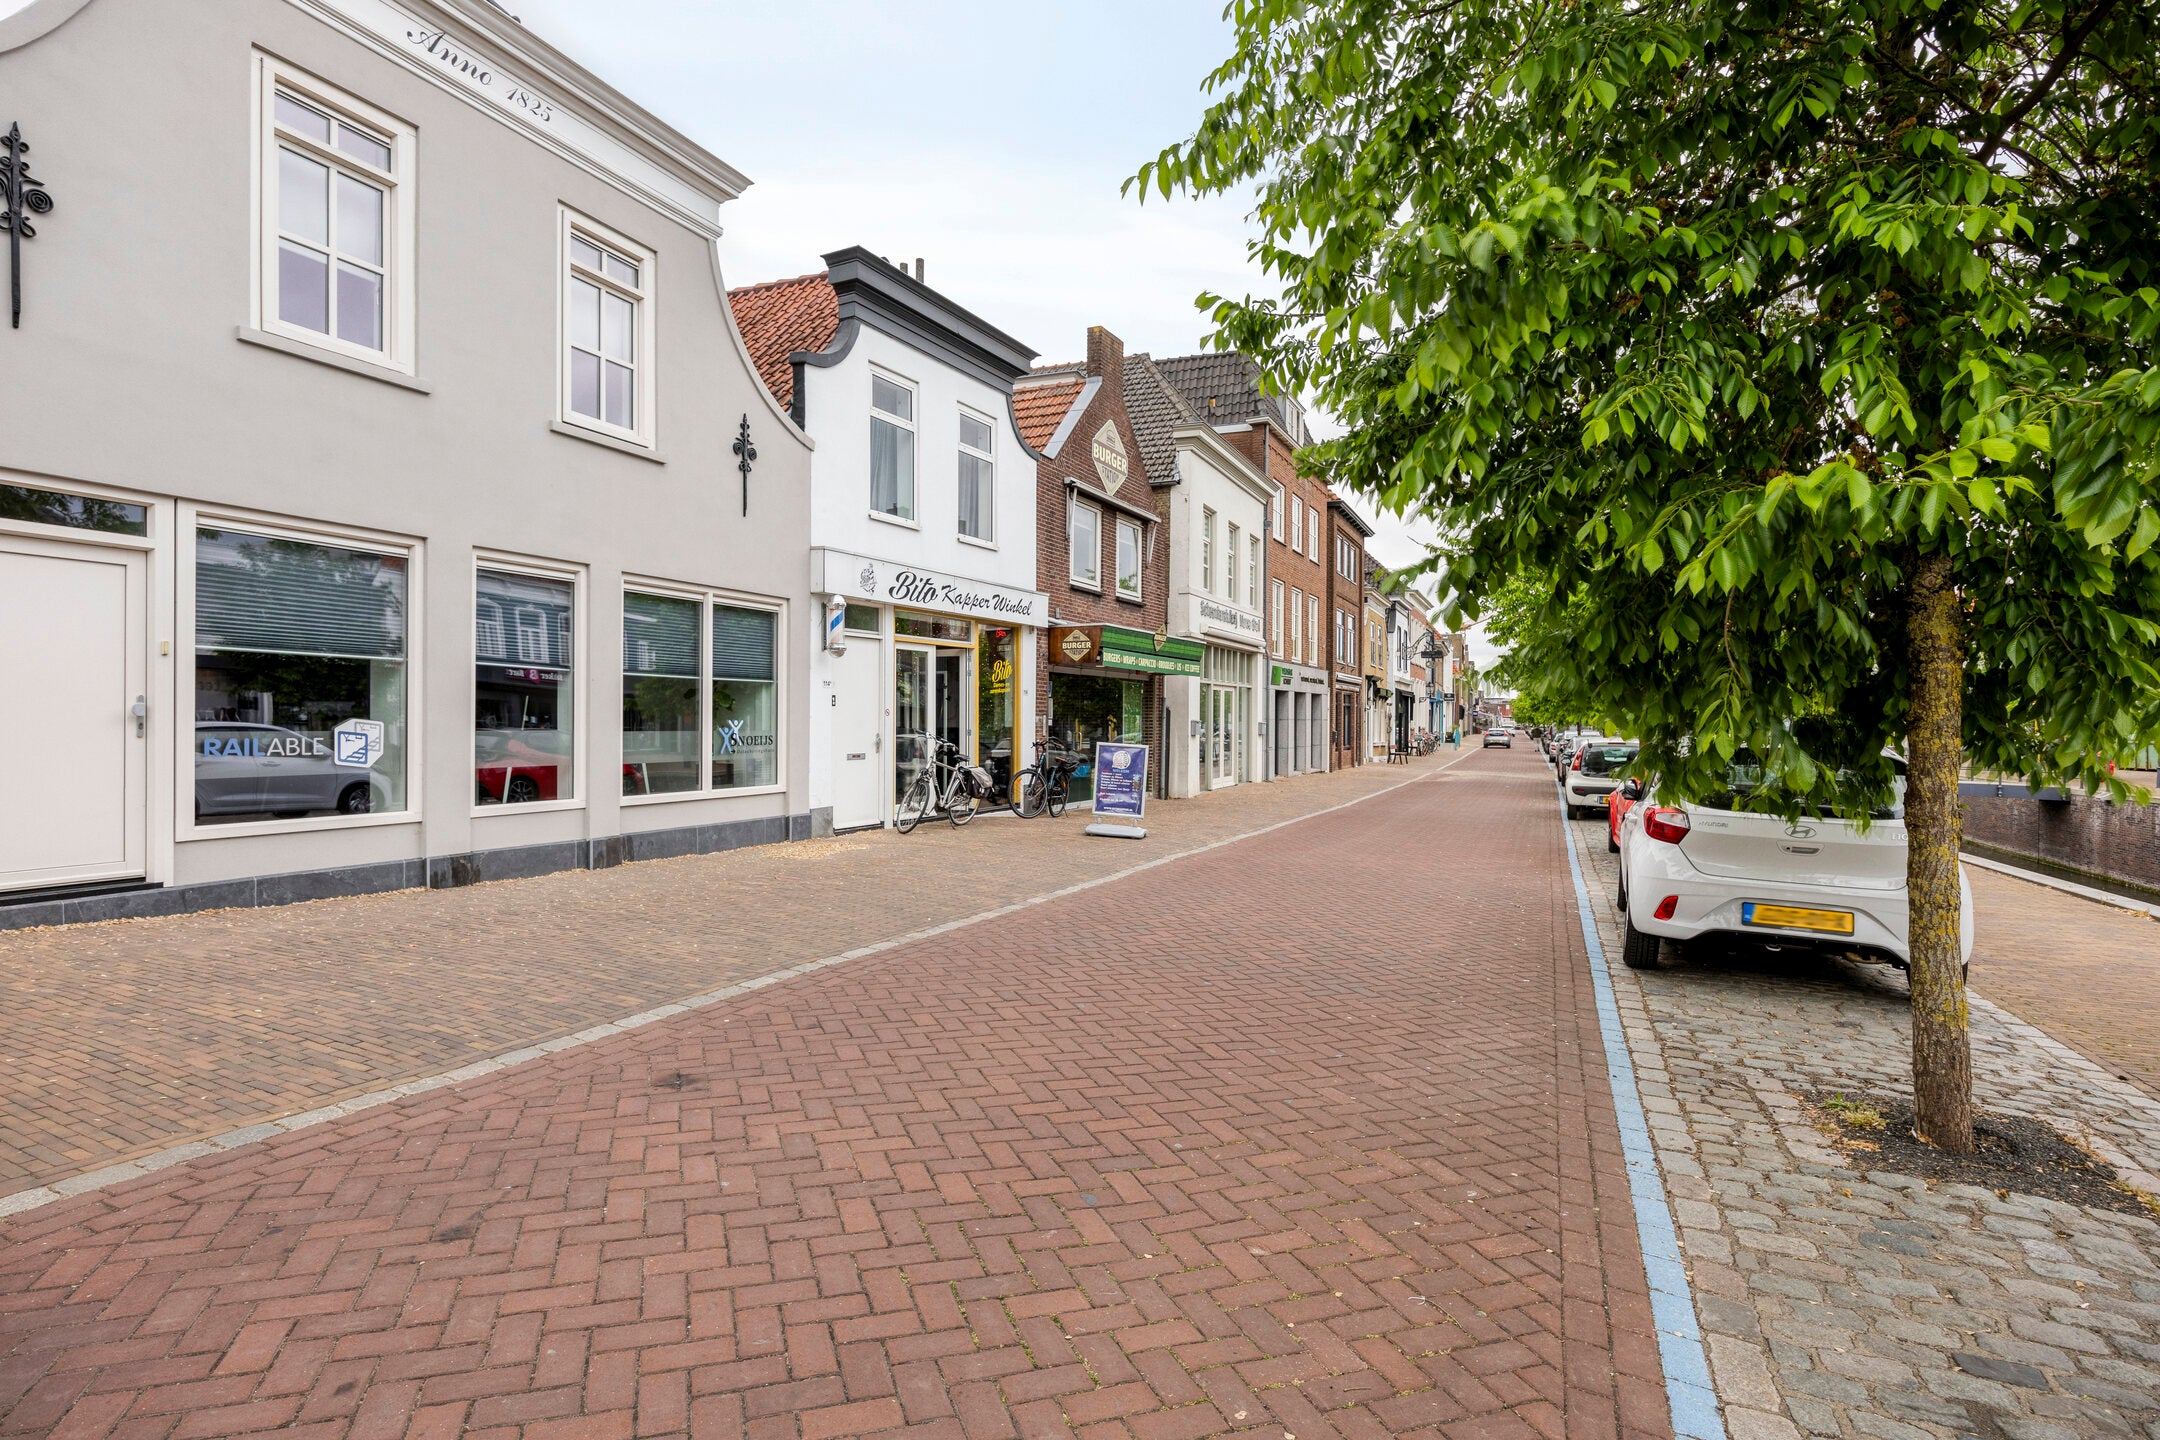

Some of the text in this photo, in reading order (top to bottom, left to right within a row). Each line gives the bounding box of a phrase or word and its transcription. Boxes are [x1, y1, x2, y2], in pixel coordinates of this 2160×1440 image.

[406, 30, 553, 122] Anno 1825
[1093, 442, 1128, 475] BURGER
[888, 571, 1033, 616] Bito Kapper Winkel
[1062, 641, 1092, 649] BURGER
[991, 659, 1013, 682] Bito
[730, 733, 774, 747] SNOEIJS
